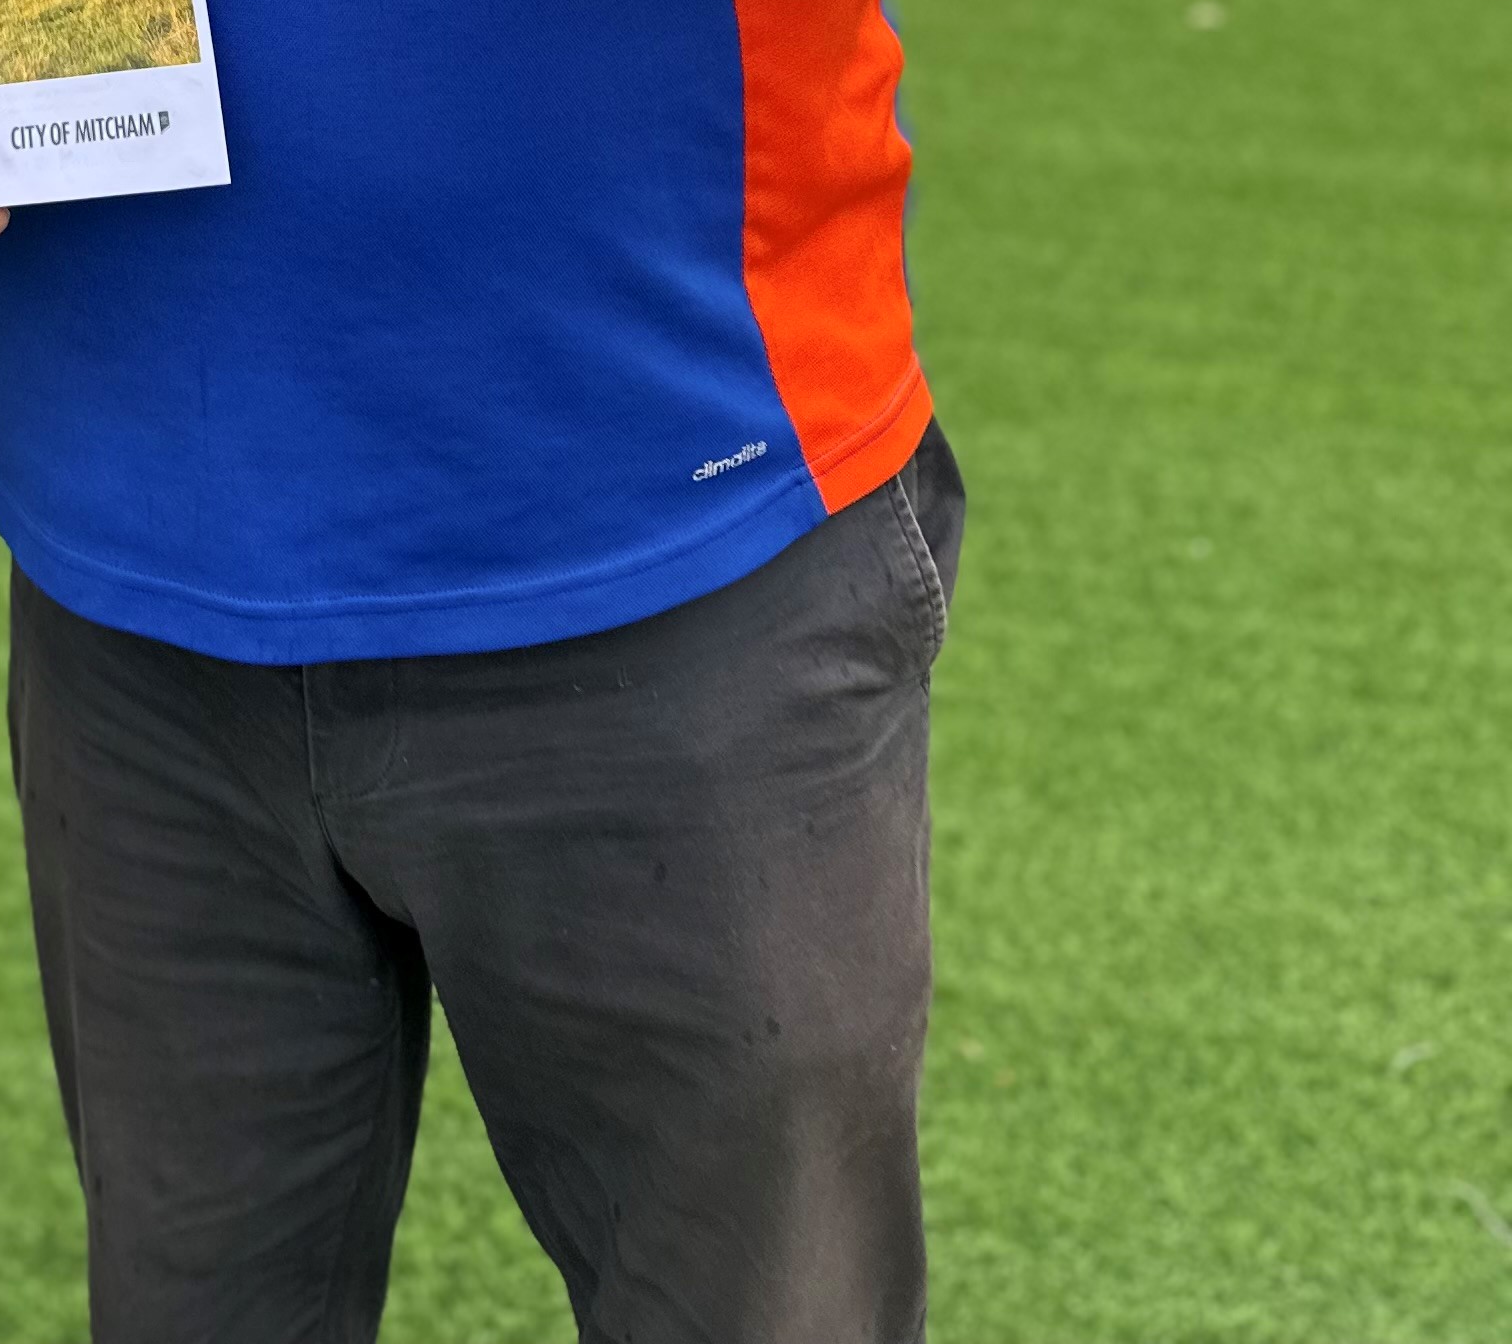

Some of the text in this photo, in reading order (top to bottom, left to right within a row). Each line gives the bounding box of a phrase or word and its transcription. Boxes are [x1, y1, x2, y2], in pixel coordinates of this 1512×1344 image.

[11, 112, 156, 150] CITY OF MITCHAM
